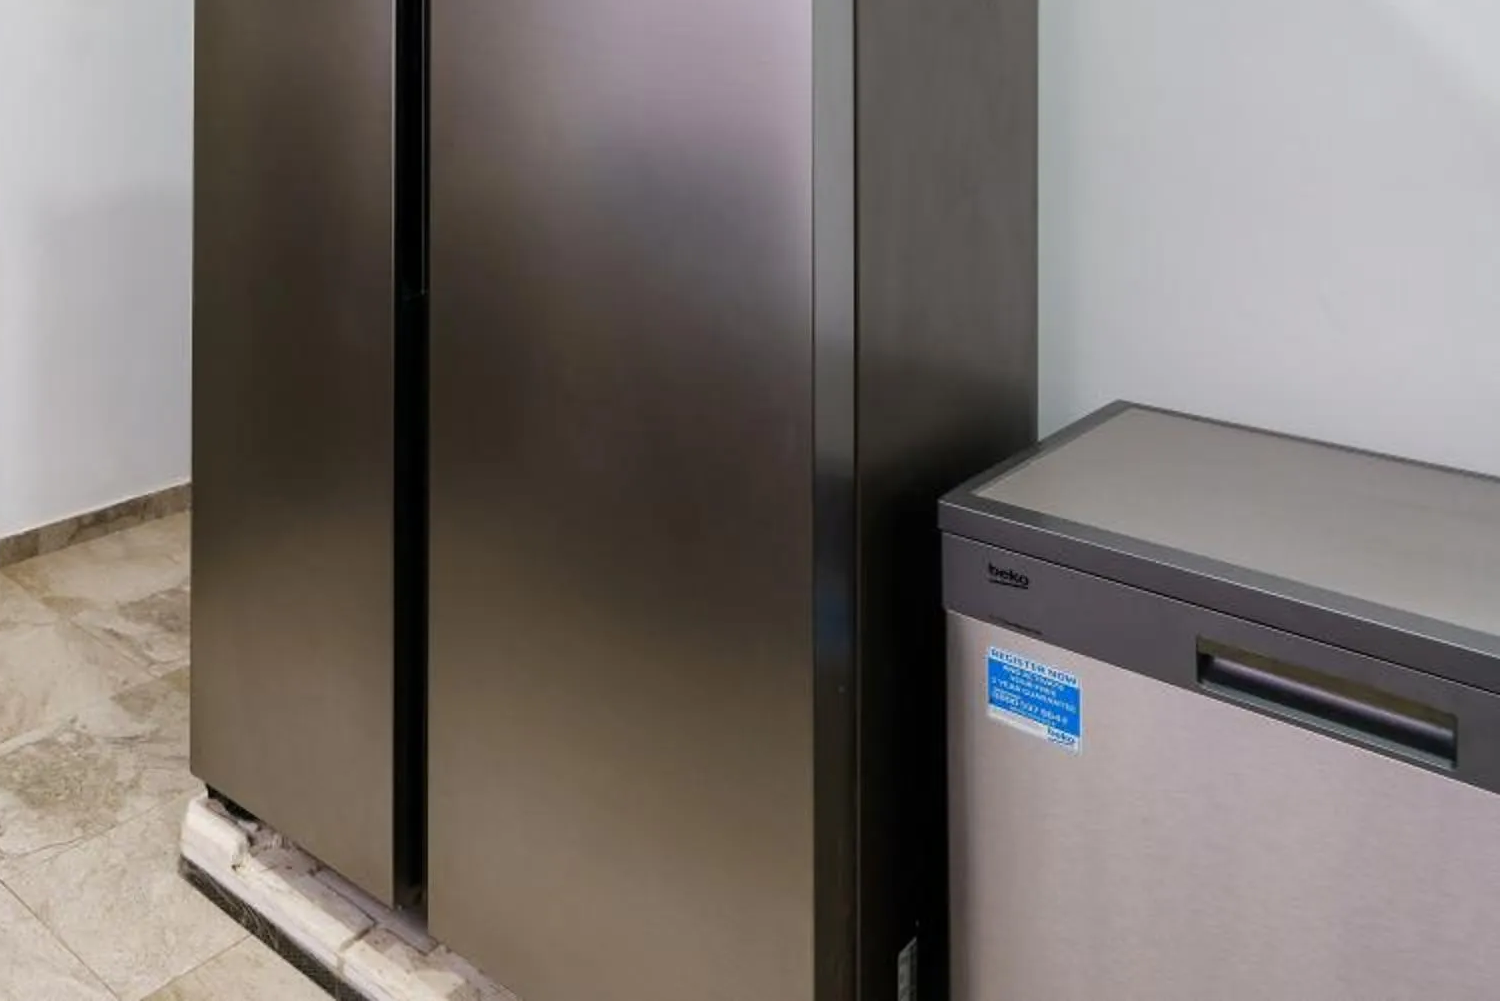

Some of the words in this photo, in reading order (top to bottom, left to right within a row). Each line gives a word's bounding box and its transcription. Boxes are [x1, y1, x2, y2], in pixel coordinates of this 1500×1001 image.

[988, 562, 1030, 586] beko
[991, 648, 1045, 673] REGISTER
[1047, 668, 1077, 685] NOW
